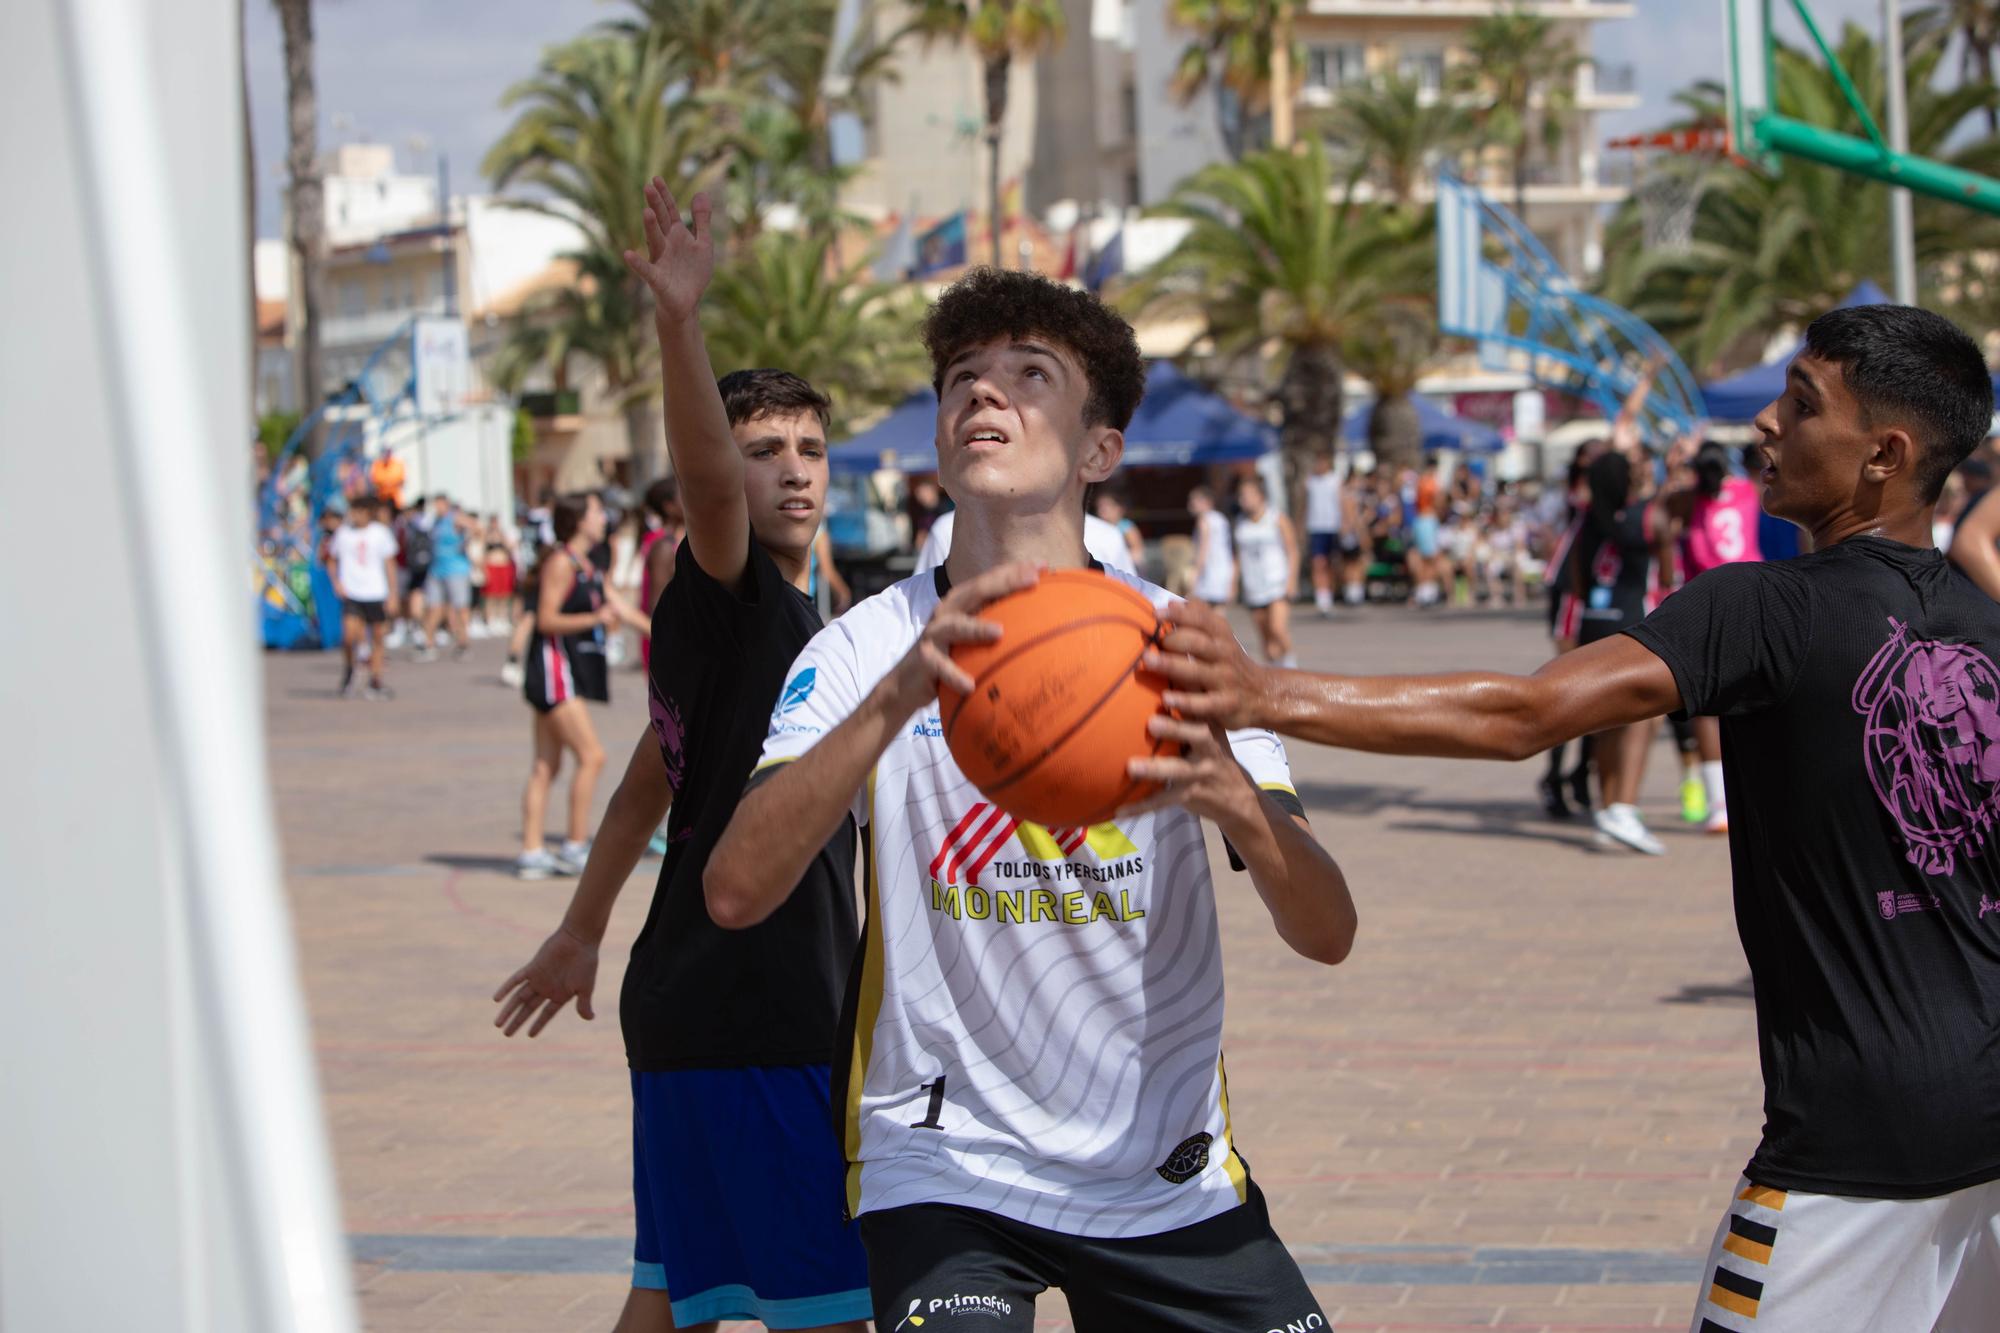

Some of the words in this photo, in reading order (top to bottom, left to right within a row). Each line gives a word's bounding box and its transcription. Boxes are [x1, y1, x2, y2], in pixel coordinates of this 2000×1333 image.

[1713, 507, 1745, 560] 3
[993, 861, 1051, 880] TOLDOS
[1053, 864, 1063, 882] Y
[1064, 857, 1144, 883] PERSIANAS
[931, 879, 1145, 925] MONREAL
[910, 1074, 946, 1131] 1
[929, 1293, 1012, 1315] Primafrio
